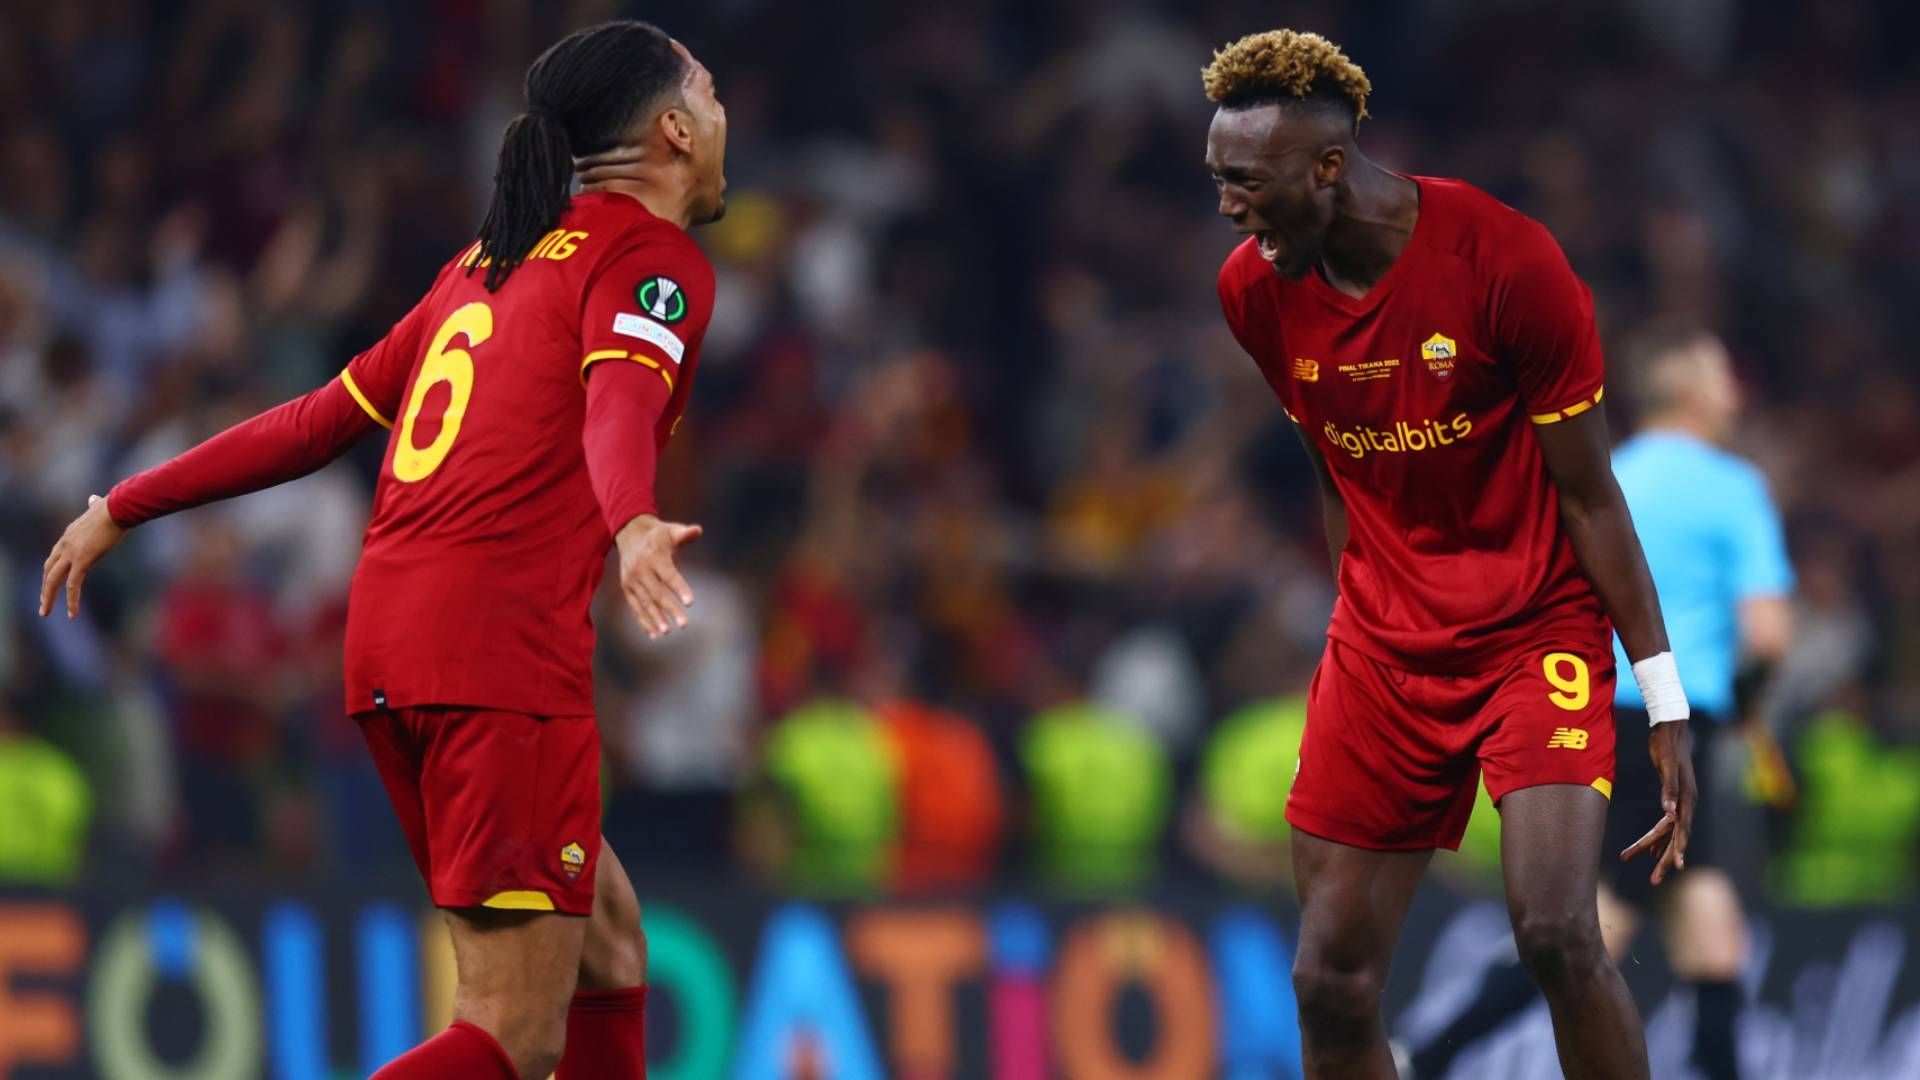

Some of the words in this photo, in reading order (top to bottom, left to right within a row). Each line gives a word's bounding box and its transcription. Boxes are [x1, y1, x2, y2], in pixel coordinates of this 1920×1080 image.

[392, 301, 494, 483] 6
[1338, 364, 1358, 372] FINAL
[1358, 361, 1383, 370] TIRANA
[1428, 361, 1455, 370] ROMA
[1324, 412, 1473, 459] digitalbits
[1542, 652, 1591, 711] 9
[0, 898, 1303, 1080] FOUDATIO
